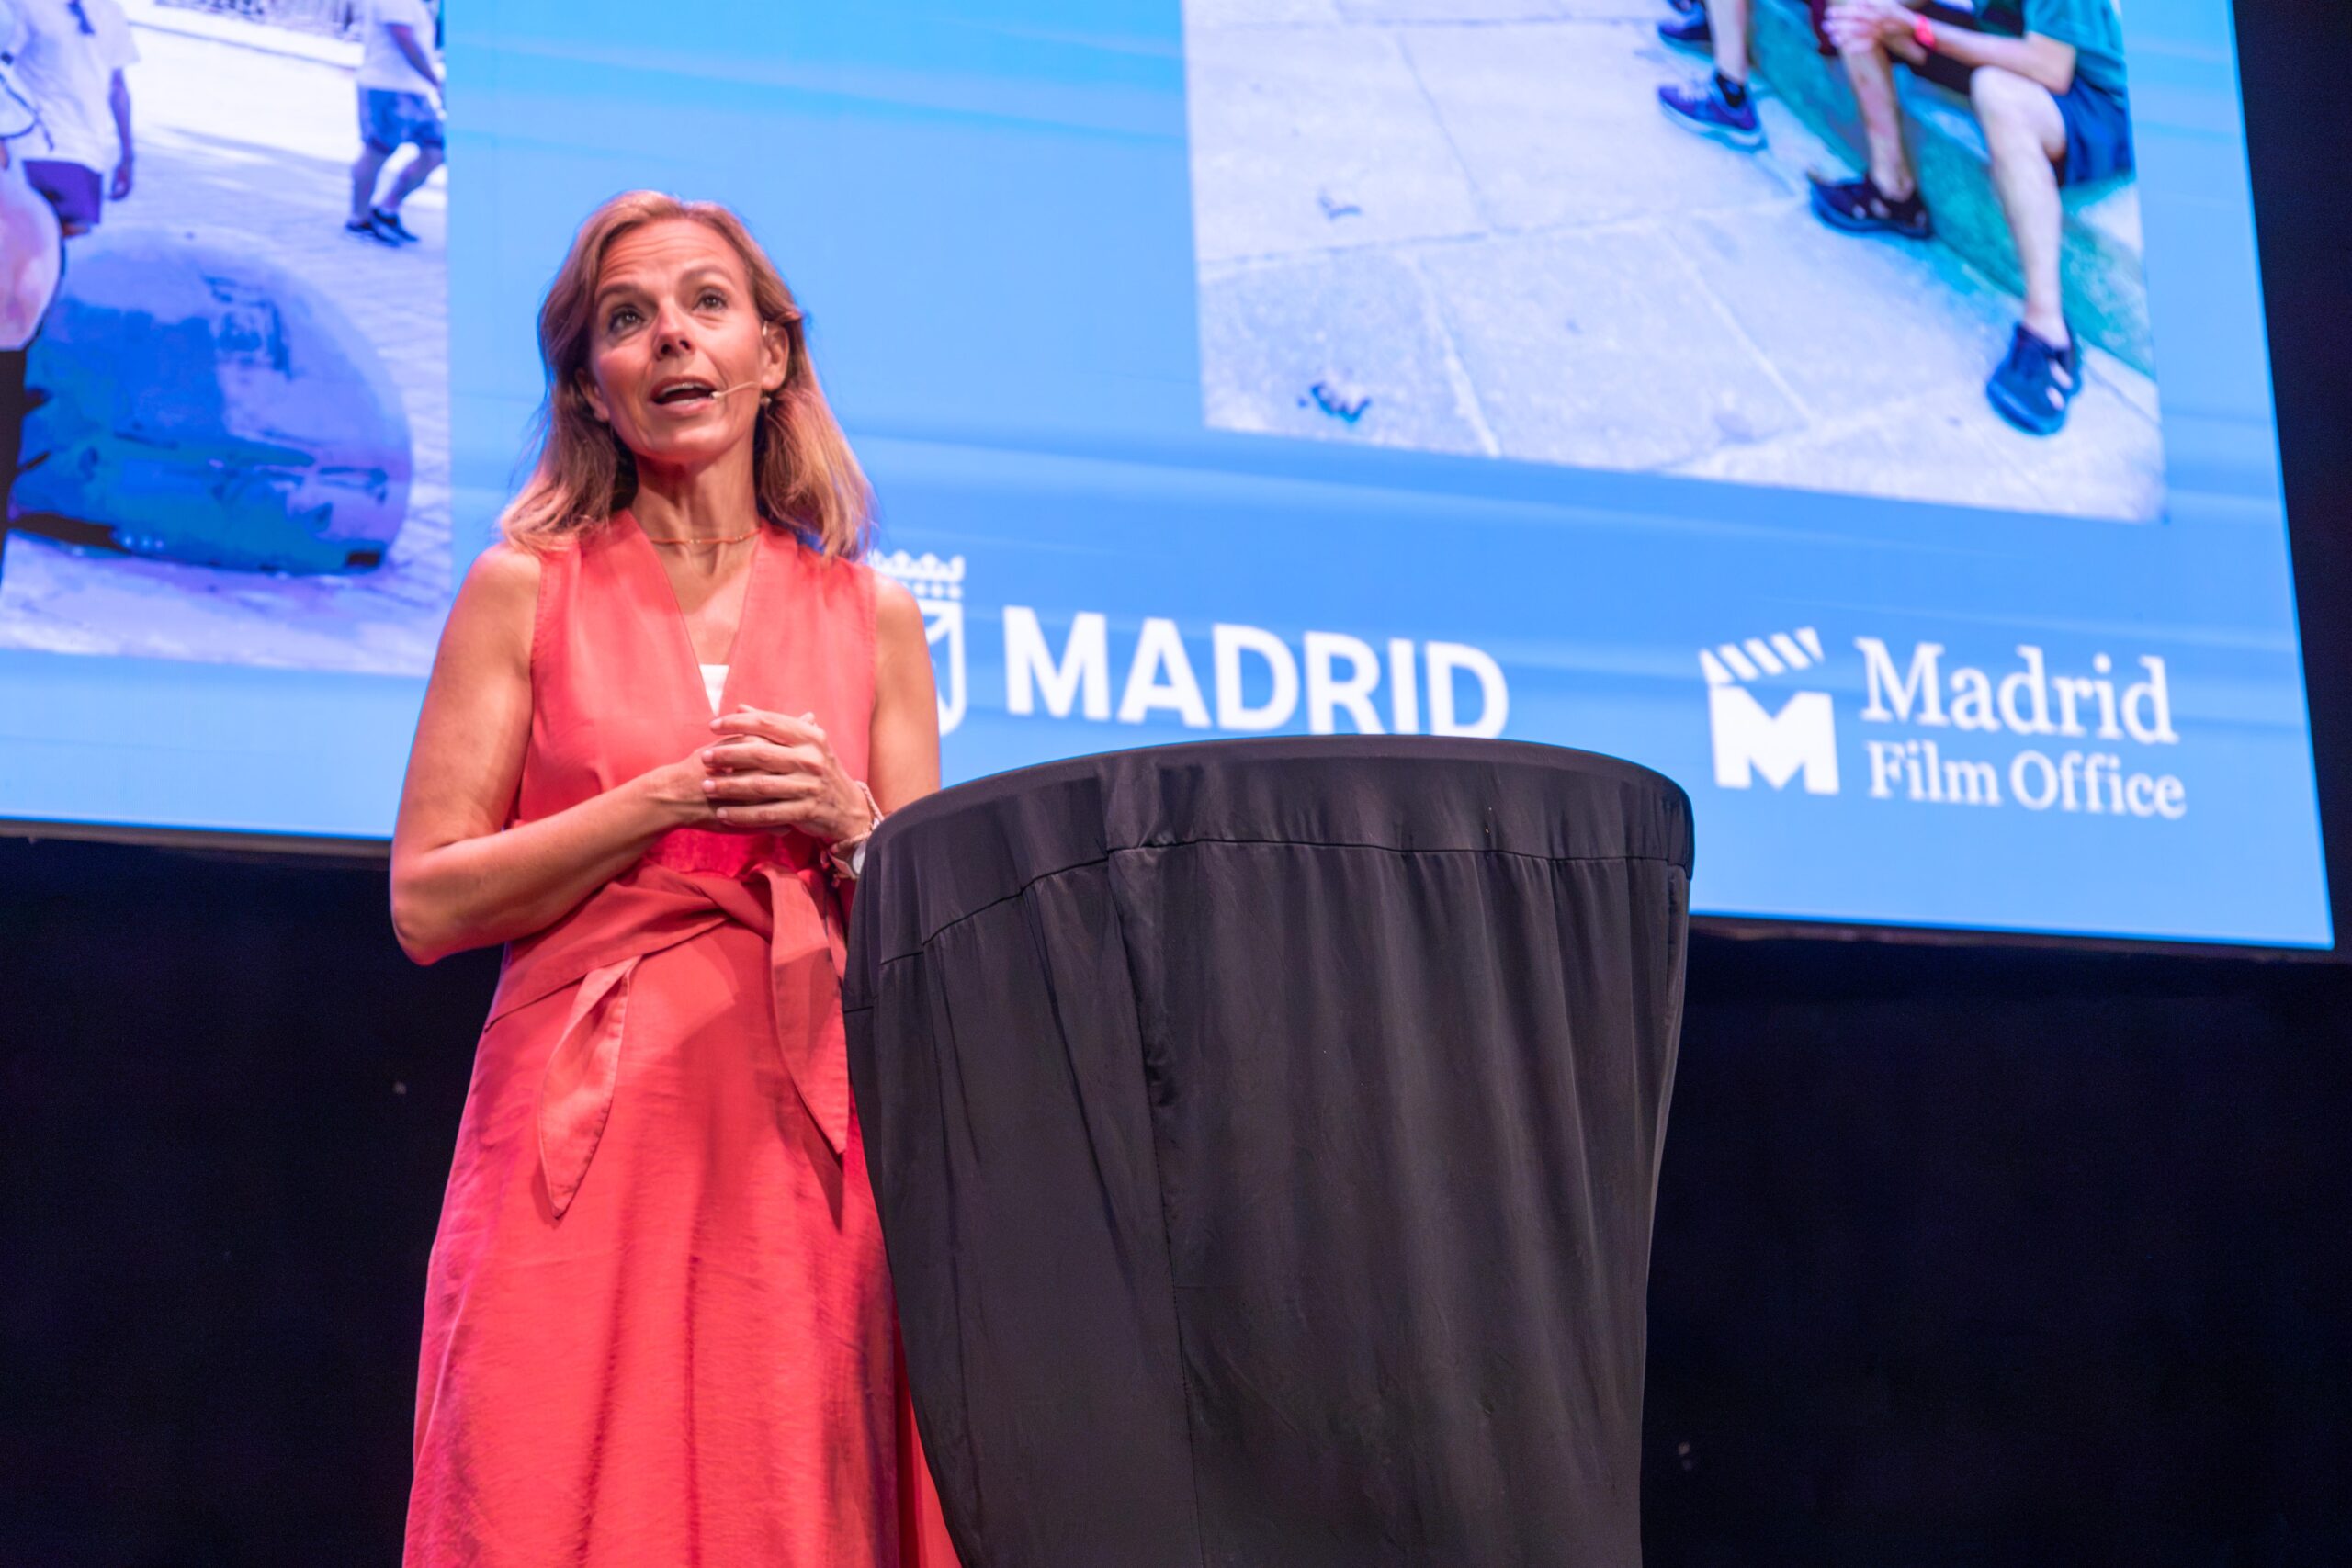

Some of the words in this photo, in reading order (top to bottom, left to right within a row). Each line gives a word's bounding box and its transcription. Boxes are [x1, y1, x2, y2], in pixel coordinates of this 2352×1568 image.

[1002, 605, 1510, 739] MADRID
[1856, 636, 2179, 745] Madrid
[1868, 739, 2002, 806] Film
[2008, 750, 2187, 819] Office
